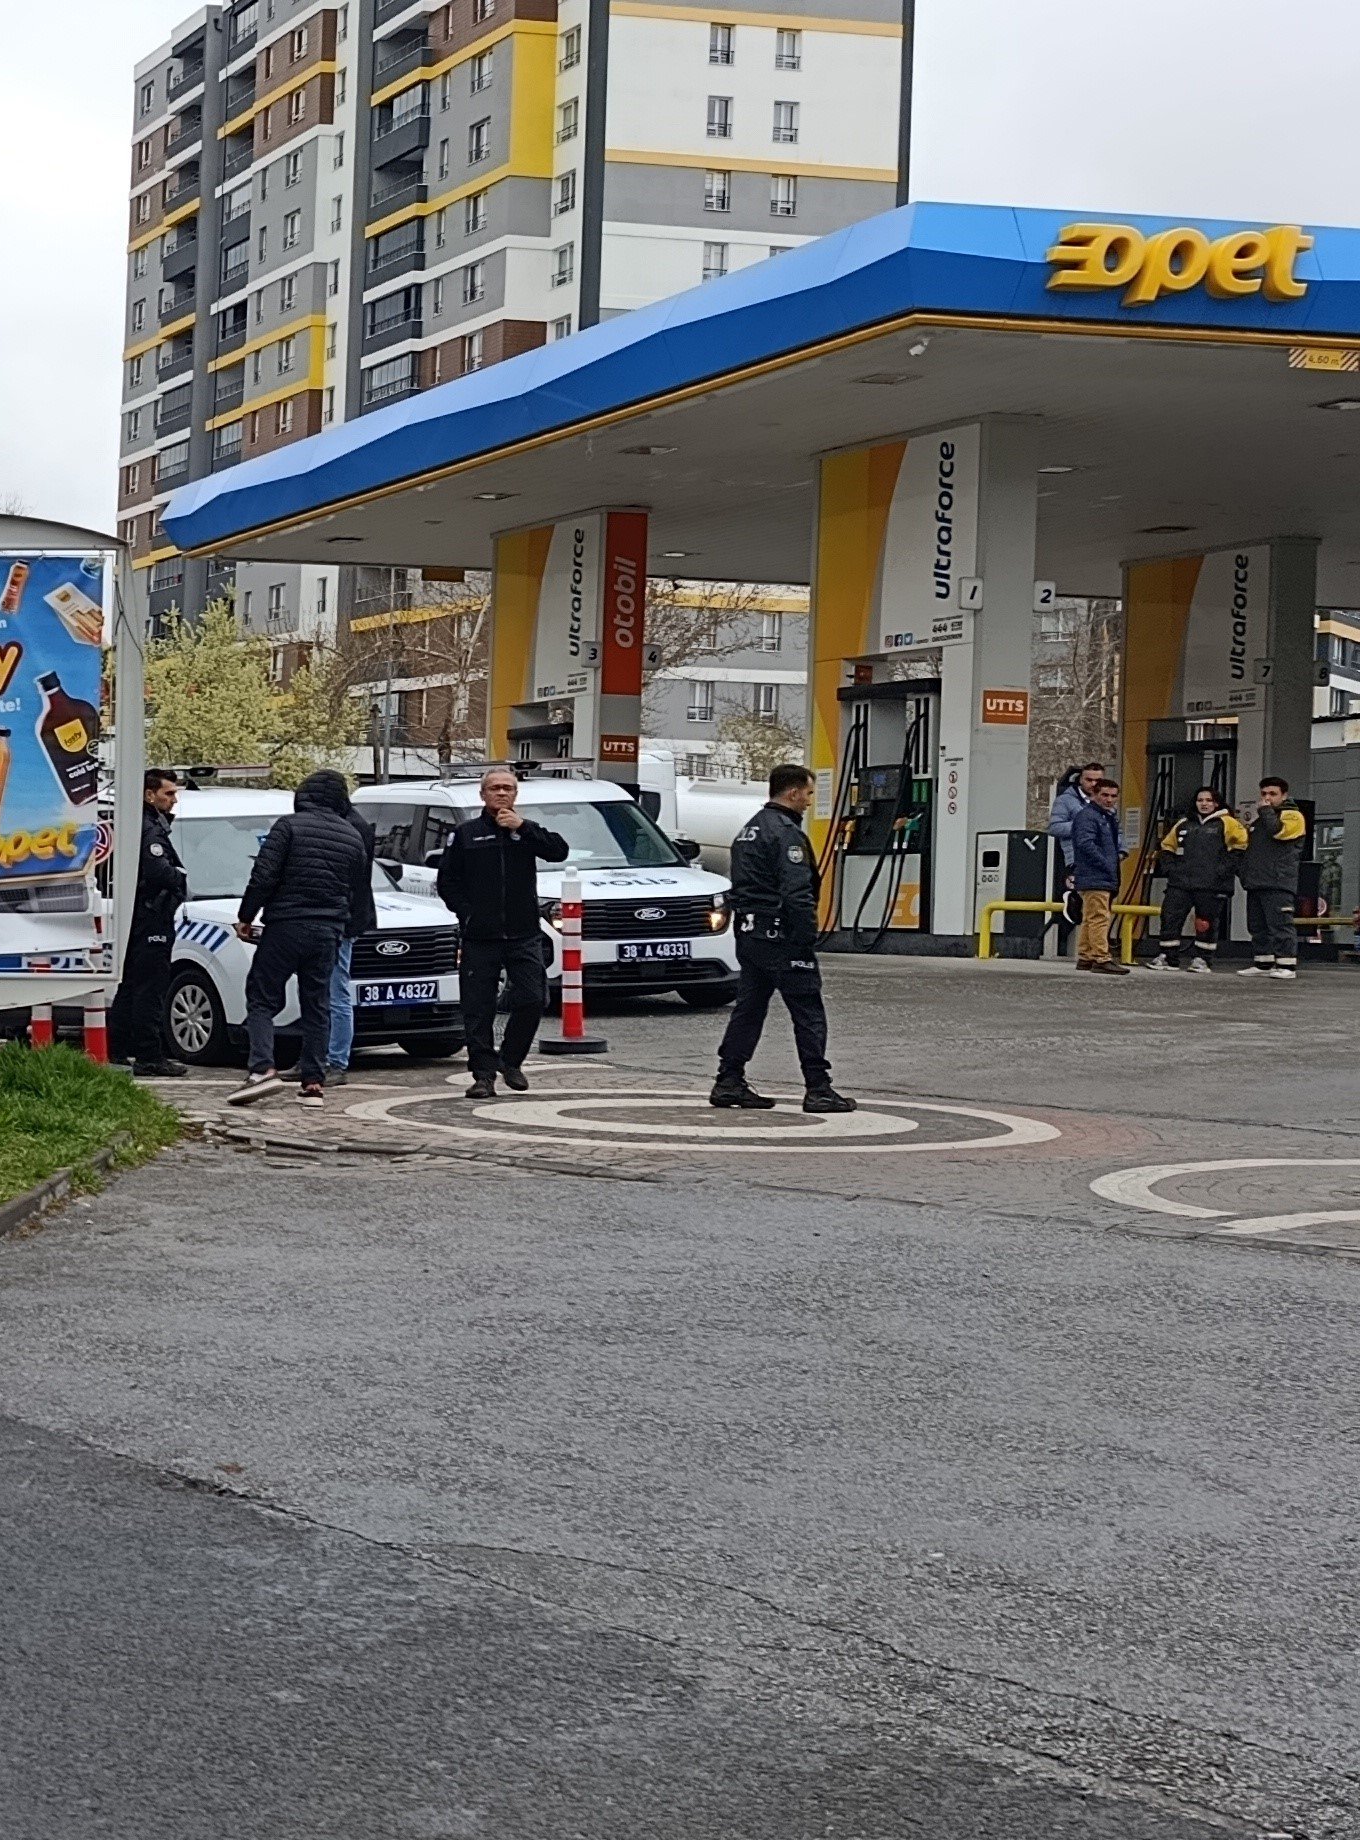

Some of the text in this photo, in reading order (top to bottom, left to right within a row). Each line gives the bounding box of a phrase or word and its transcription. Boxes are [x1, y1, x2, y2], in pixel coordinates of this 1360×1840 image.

[1046, 222, 1315, 307] opet
[933, 441, 955, 600] ultraforce
[568, 528, 585, 657] ultraforce
[1040, 588, 1052, 604] 2
[613, 555, 637, 648] otobil
[1231, 554, 1249, 680] ultraforce
[588, 647, 598, 661] 3
[648, 650, 658, 663] 4
[1262, 665, 1271, 678] 7
[986, 698, 1025, 712] UTTS
[602, 741, 635, 752] UTTS
[623, 943, 689, 958] 38 A 48331
[364, 983, 436, 1001] 38 A 48327
